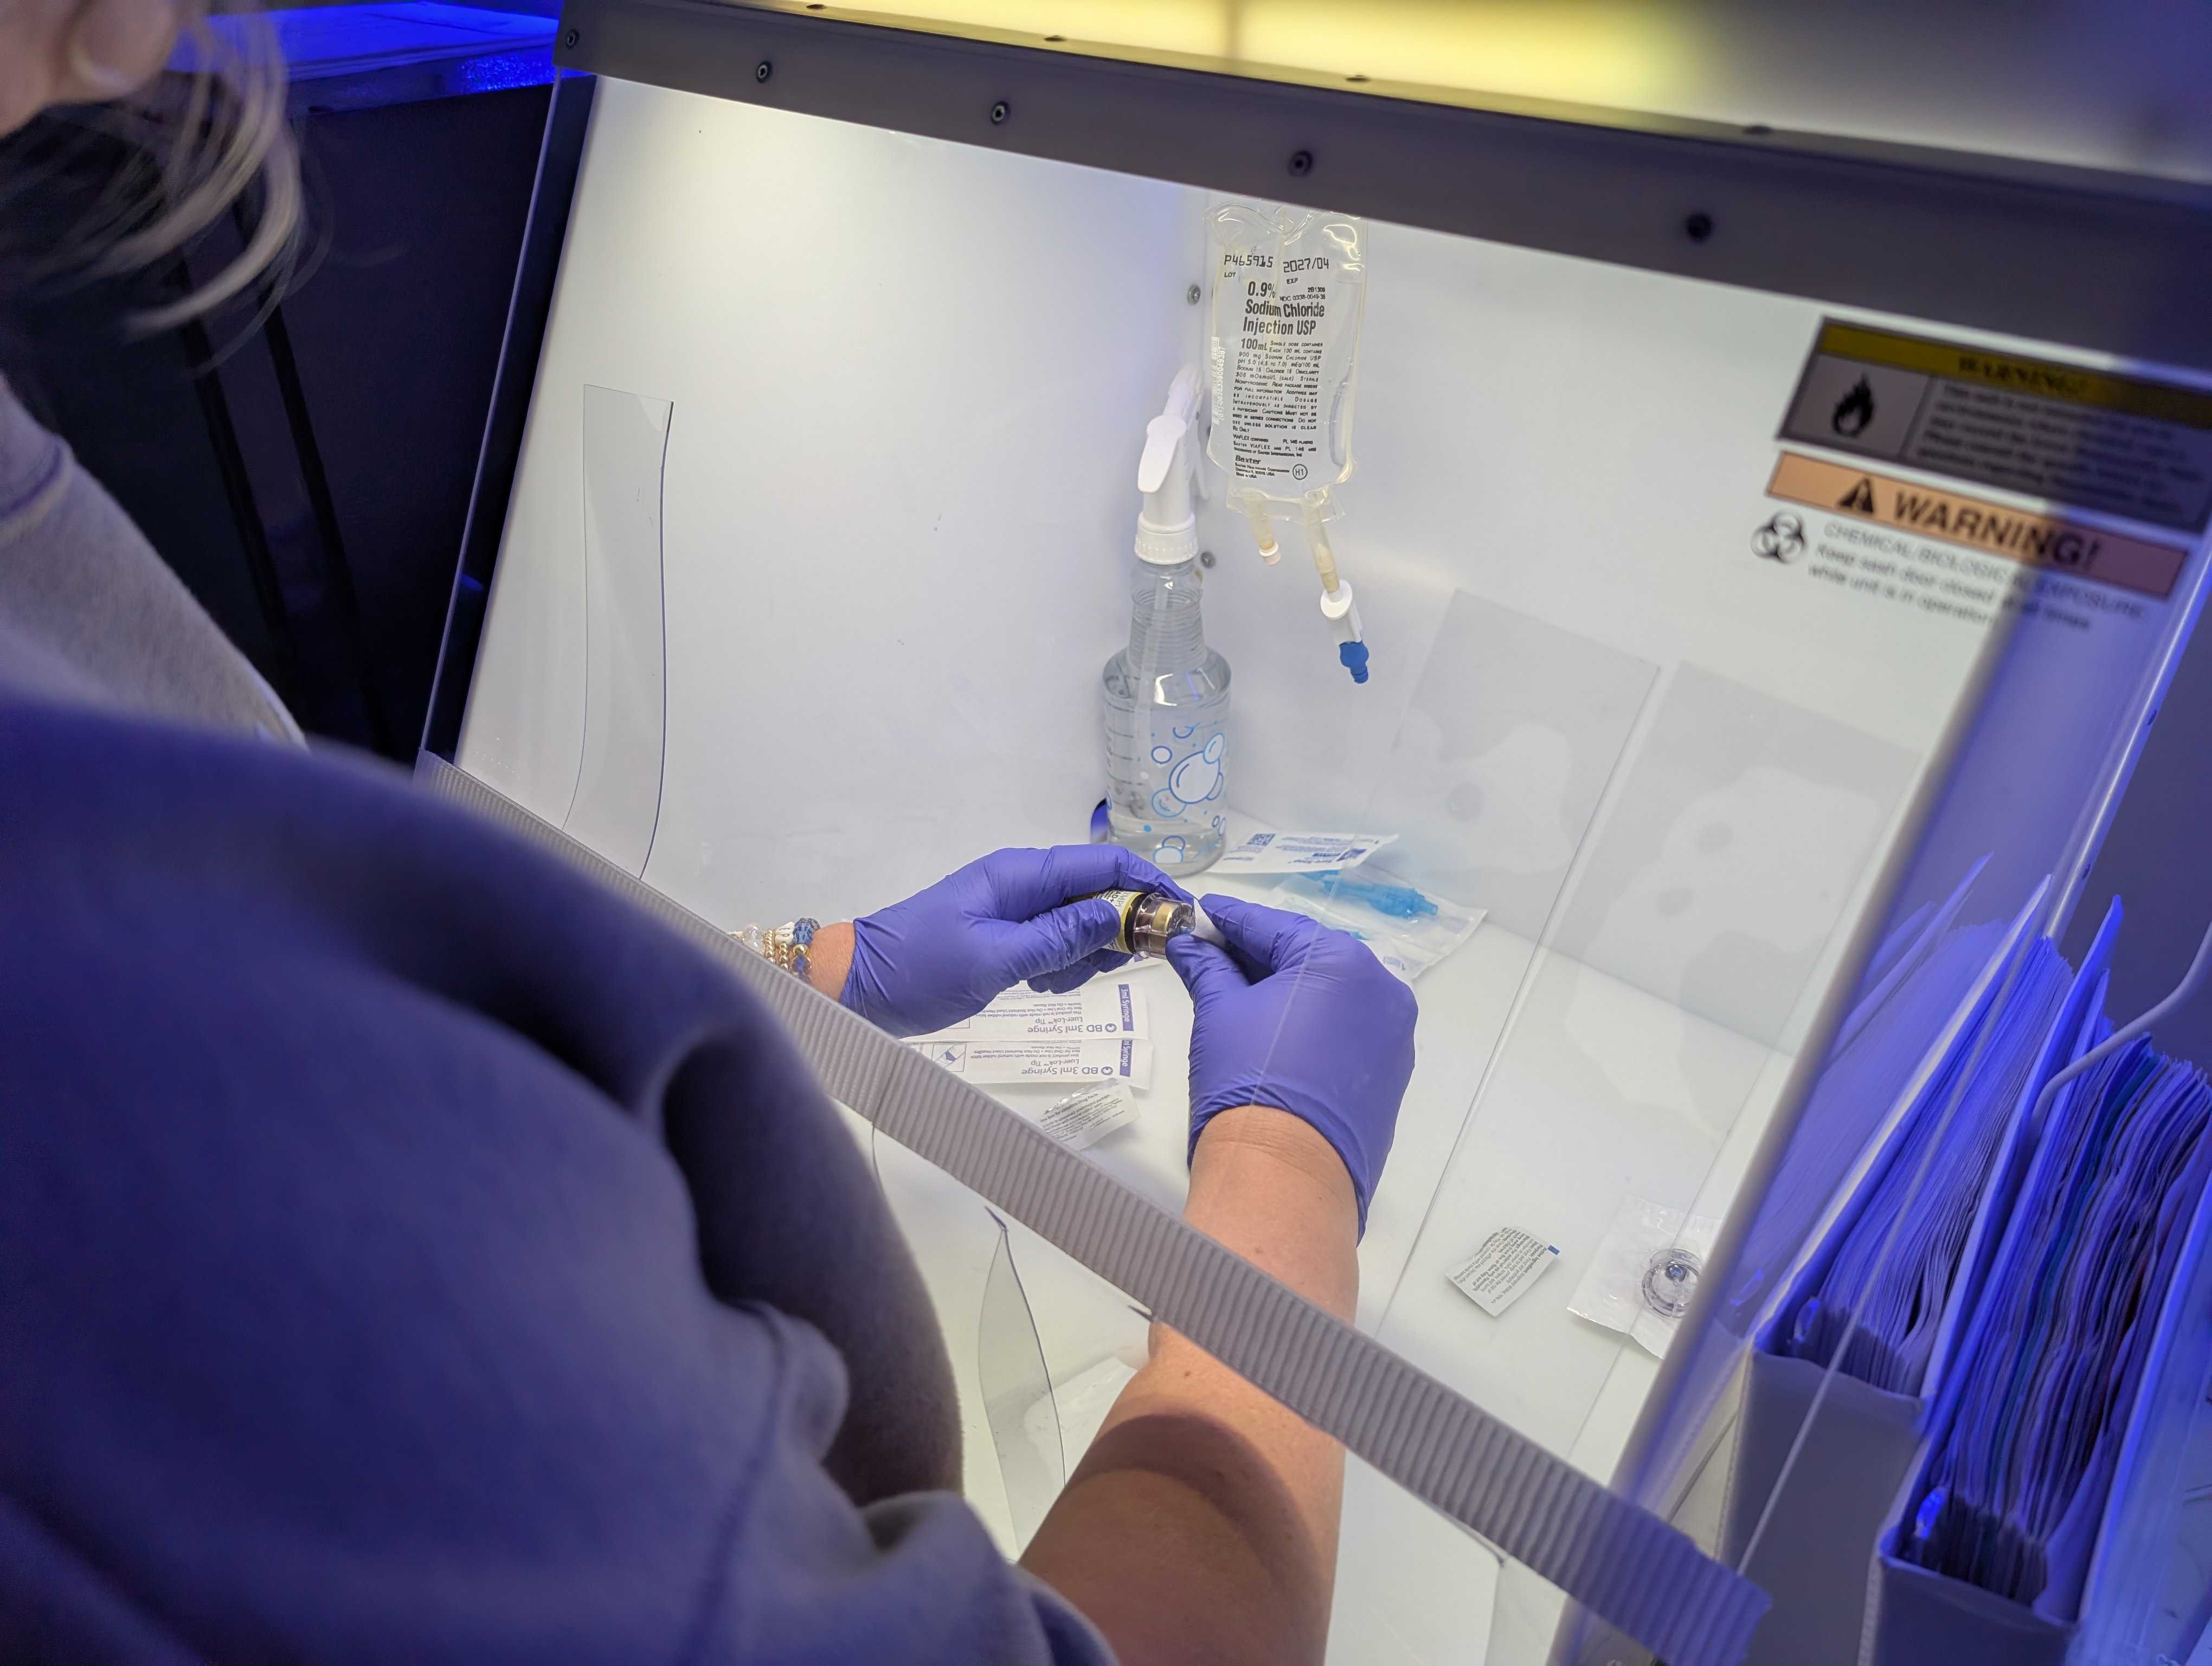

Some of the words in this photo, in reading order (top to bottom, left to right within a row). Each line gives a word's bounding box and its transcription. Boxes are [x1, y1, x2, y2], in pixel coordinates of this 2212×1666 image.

[1224, 254, 1274, 268] P465915
[1283, 257, 1329, 273] 2027/04
[1248, 281, 1275, 298] 0.9%
[1245, 299, 1282, 317] Sodium
[1283, 302, 1324, 317] Chloride
[1243, 317, 1294, 336] Injection
[1296, 320, 1316, 335] USP
[1236, 454, 1261, 465] Baxter
[1894, 491, 2101, 571] WARNING!
[1121, 1000, 1130, 1022] Syringe
[1028, 1024, 1062, 1034] Syringe
[1066, 1024, 1083, 1033] 3ml
[1122, 1046, 1130, 1067] Syringe
[1022, 1066, 1058, 1075] Syringe
[1060, 1066, 1078, 1074] 3ml
